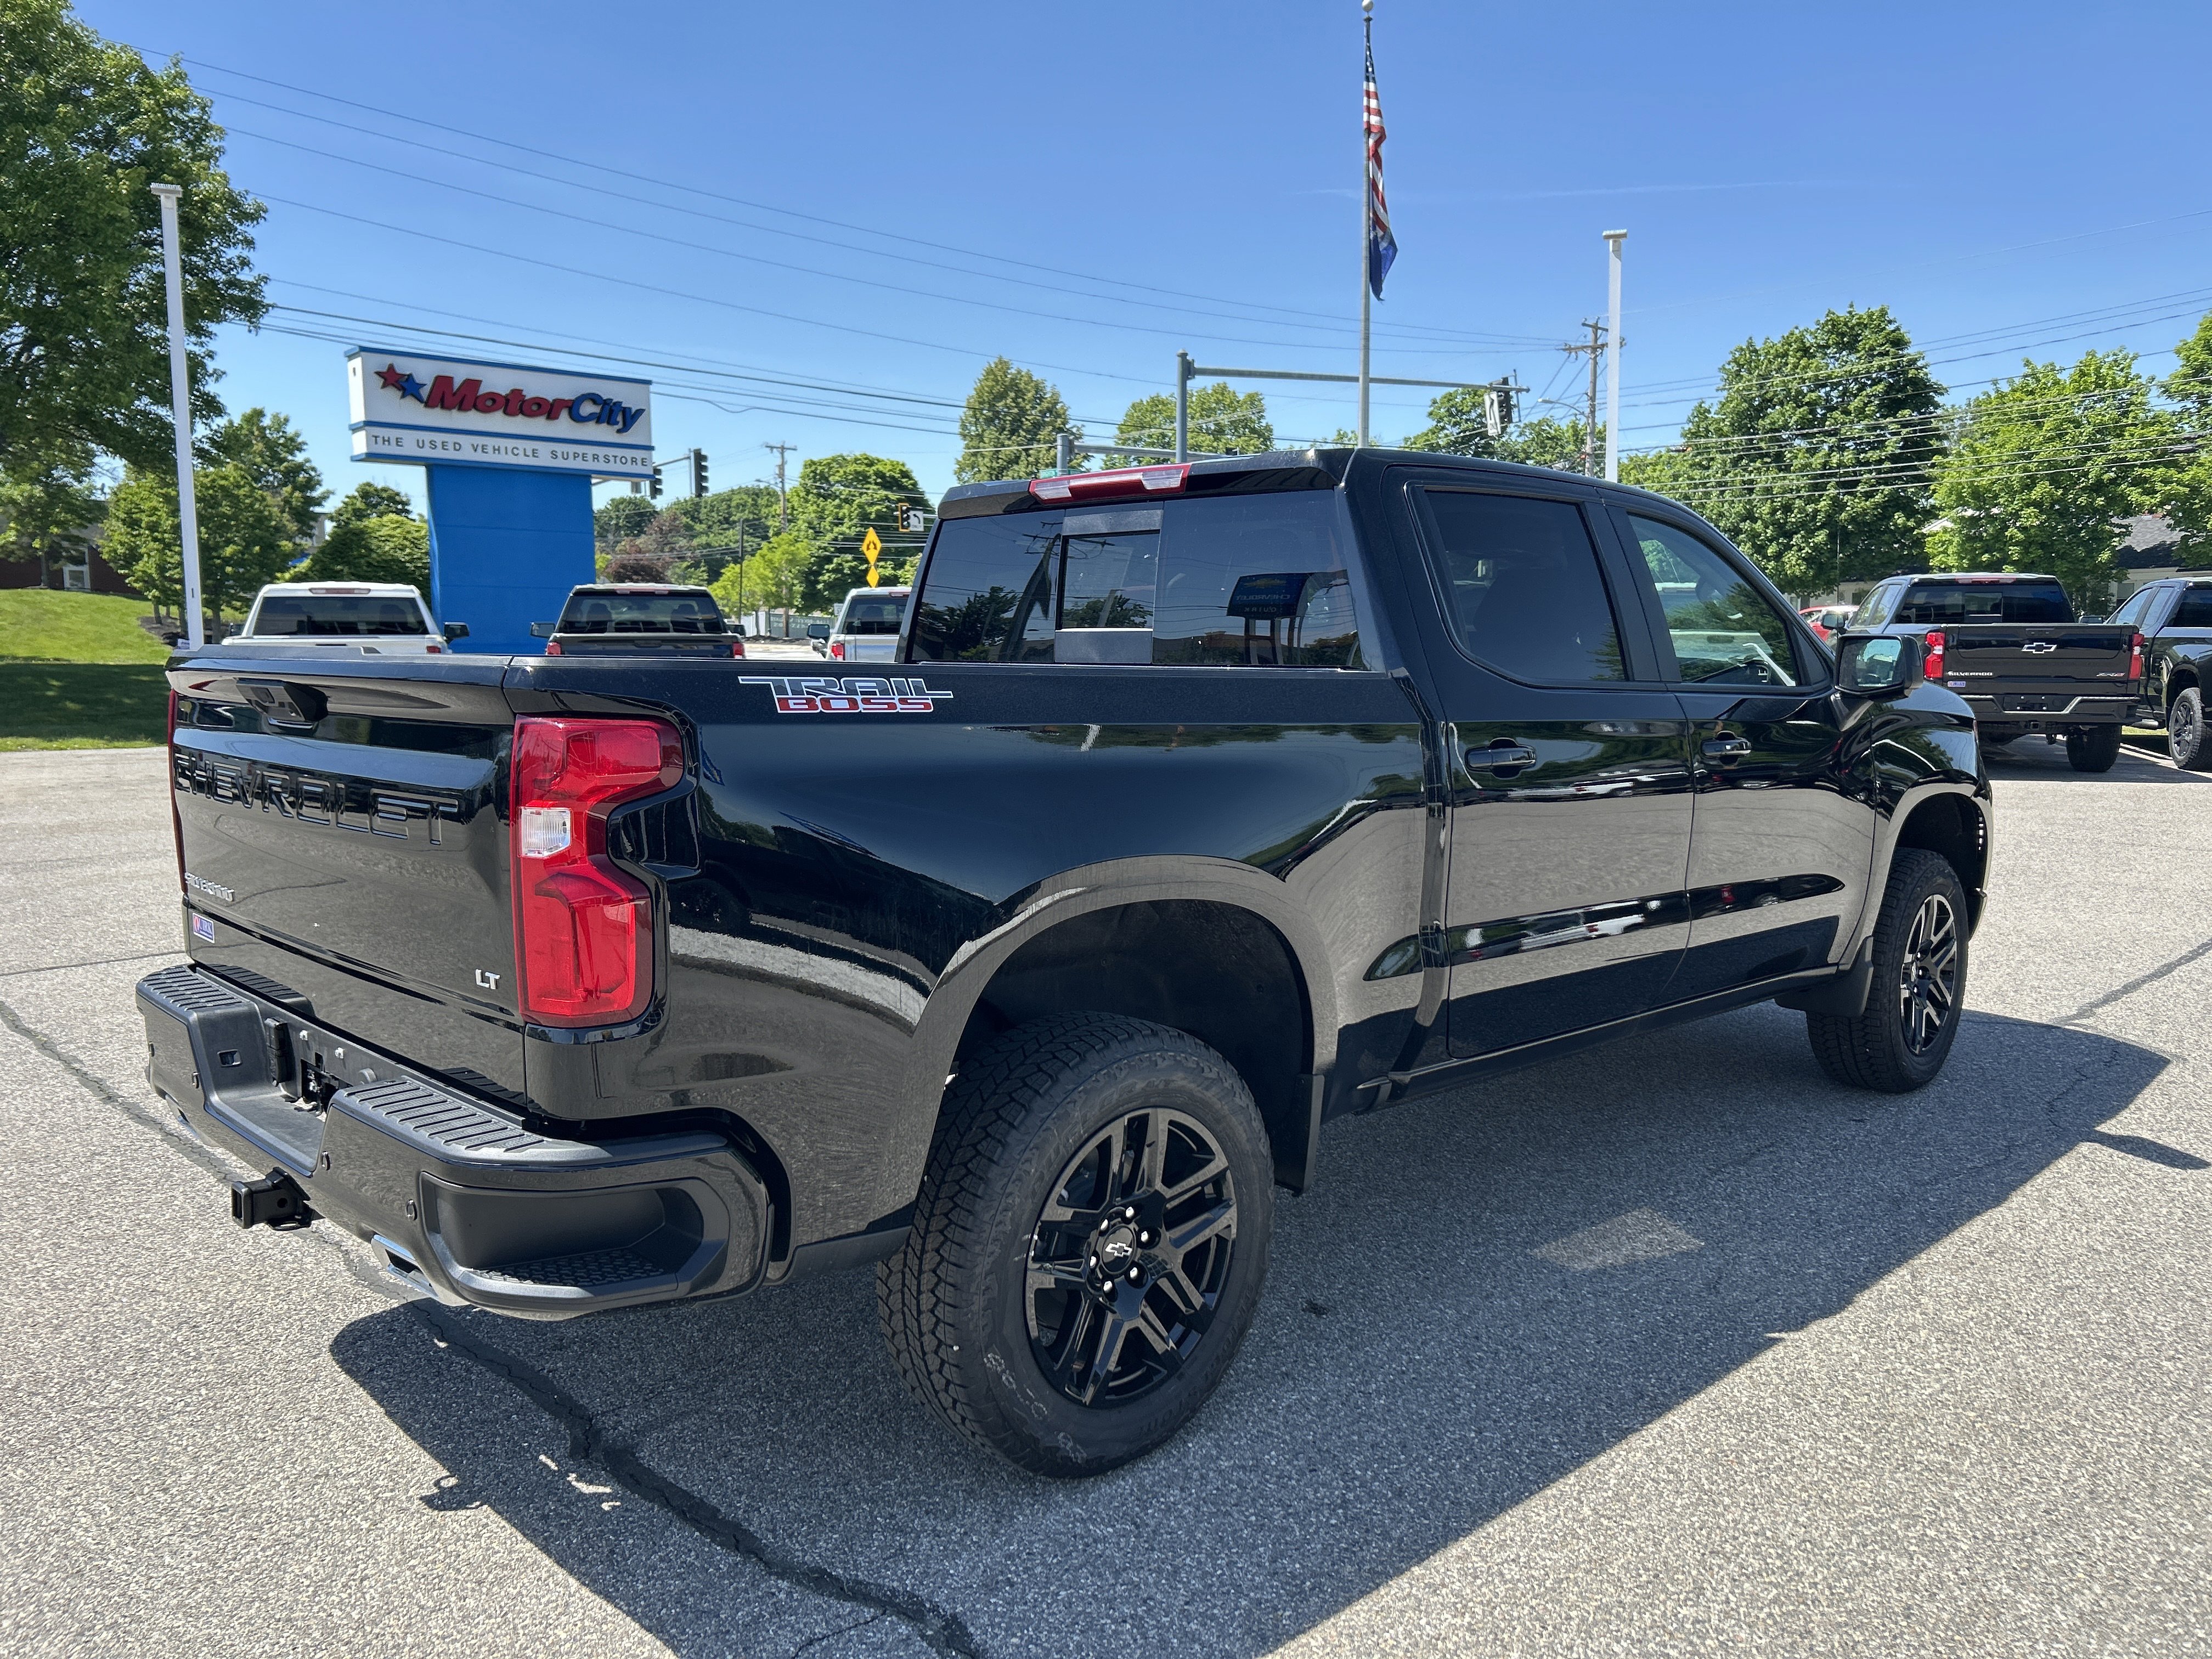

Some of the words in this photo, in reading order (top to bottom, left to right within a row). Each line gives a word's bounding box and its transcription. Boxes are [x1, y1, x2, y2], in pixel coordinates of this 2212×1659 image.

[424, 375, 646, 433] MotorCity
[371, 435, 404, 447] THE
[416, 438, 462, 452] USED
[471, 443, 539, 458] VEHICLE
[550, 450, 648, 467] SUPERSTORE
[738, 676, 953, 698] TRAIL
[776, 695, 934, 713] BOSS
[174, 752, 459, 845] CHEVROLET
[475, 969, 500, 990] LT
